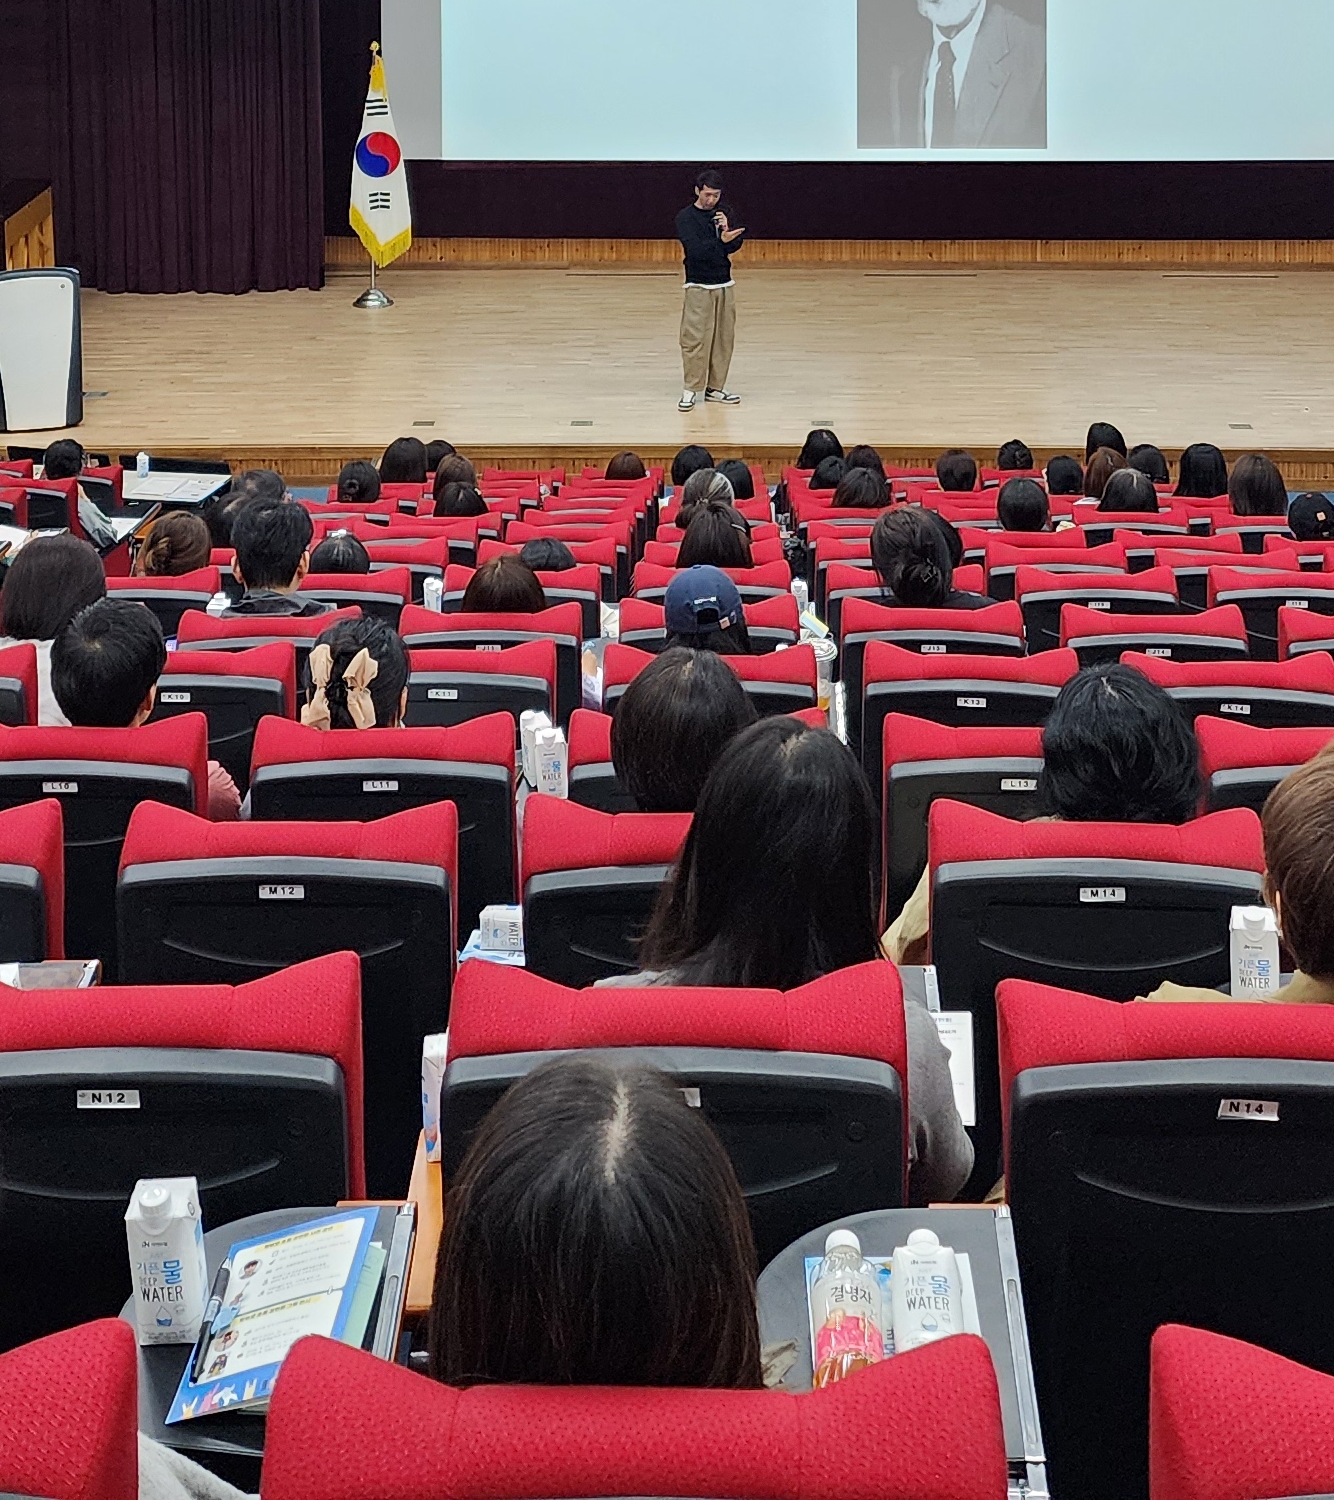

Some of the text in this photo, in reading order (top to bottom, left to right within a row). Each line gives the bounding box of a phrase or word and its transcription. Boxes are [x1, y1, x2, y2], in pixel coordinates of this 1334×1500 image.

[51, 781, 70, 790] L10
[371, 781, 390, 789] L11
[1010, 780, 1029, 788] L13
[267, 886, 295, 895] M12
[1090, 888, 1116, 898] M14
[508, 921, 519, 947] WATER
[1239, 976, 1270, 989] WATER
[91, 1092, 126, 1104] N12
[1228, 1101, 1264, 1114] N14
[160, 1259, 184, 1285] 물
[928, 1275, 952, 1298] 물
[140, 1285, 184, 1303] WATER
[830, 1284, 873, 1305] 결명자
[906, 1296, 950, 1311] WATER
